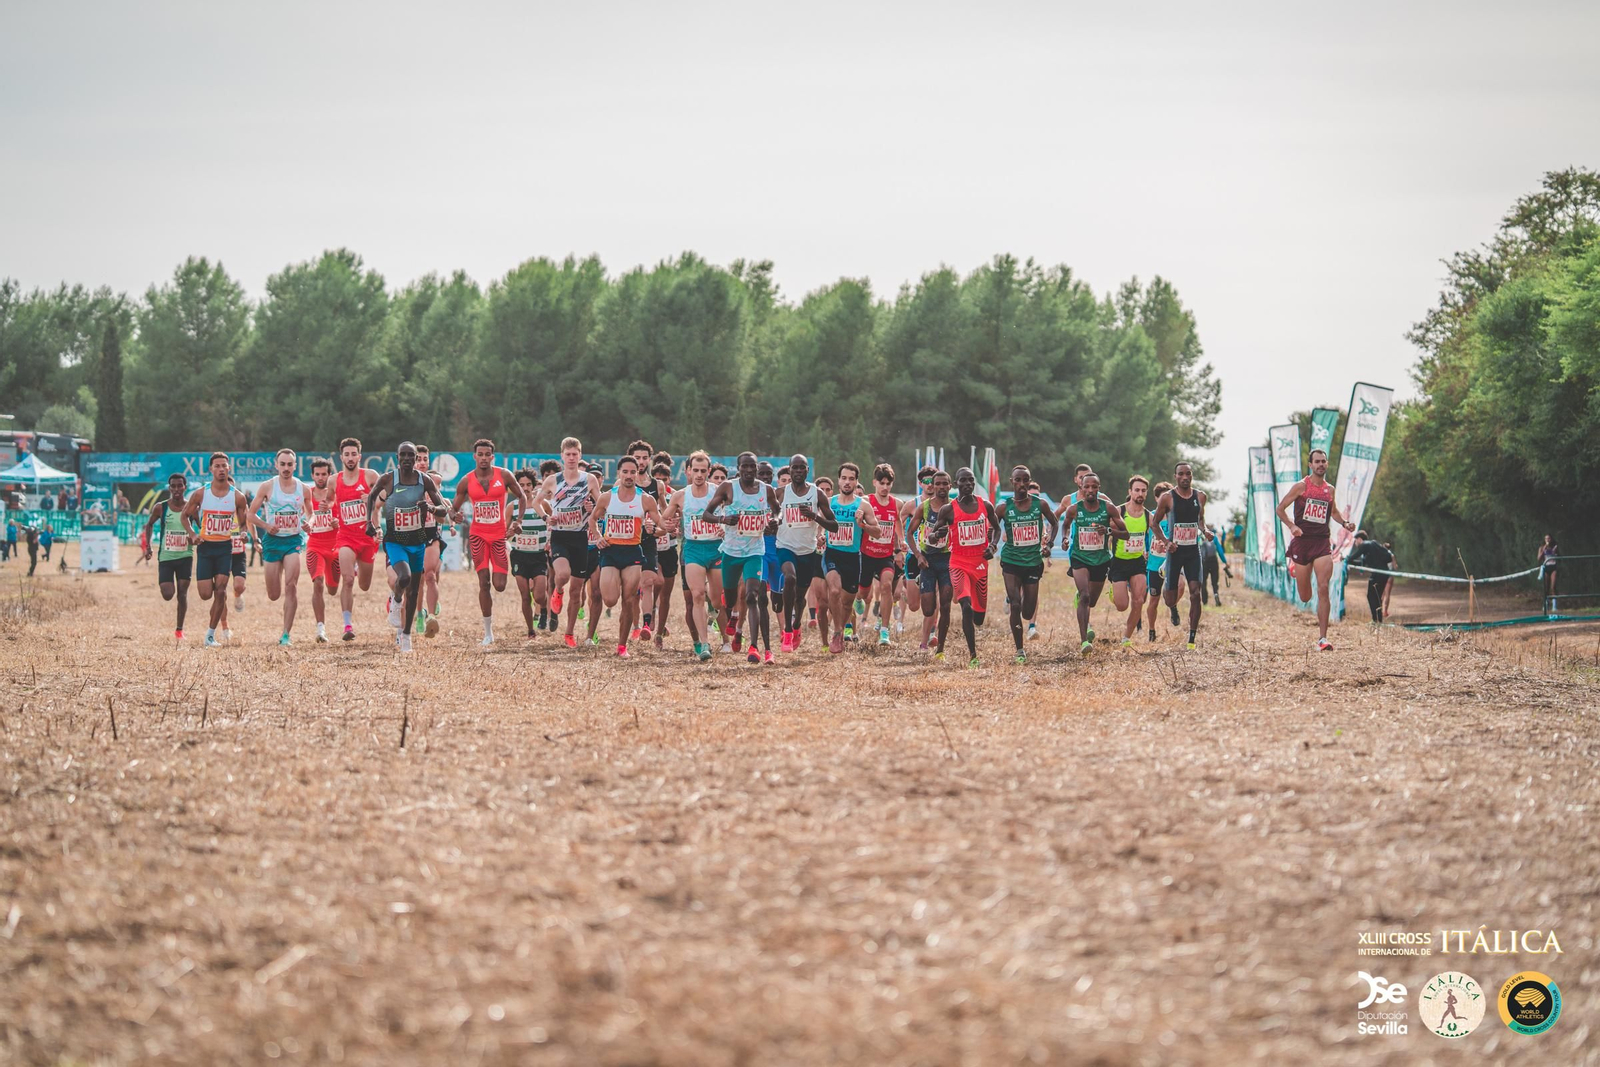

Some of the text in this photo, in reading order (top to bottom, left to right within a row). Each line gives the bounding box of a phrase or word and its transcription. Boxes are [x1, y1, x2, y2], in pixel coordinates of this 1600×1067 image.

[395, 511, 420, 526] BETT
[475, 506, 499, 519] BARROS
[1305, 504, 1327, 520] ARCE
[206, 518, 232, 532] OLIVO
[312, 514, 332, 530] AMOS
[608, 519, 634, 534] FONTES
[692, 519, 718, 534] ALFIER
[738, 516, 764, 531] KOECH
[1013, 526, 1038, 541] KWIZERA
